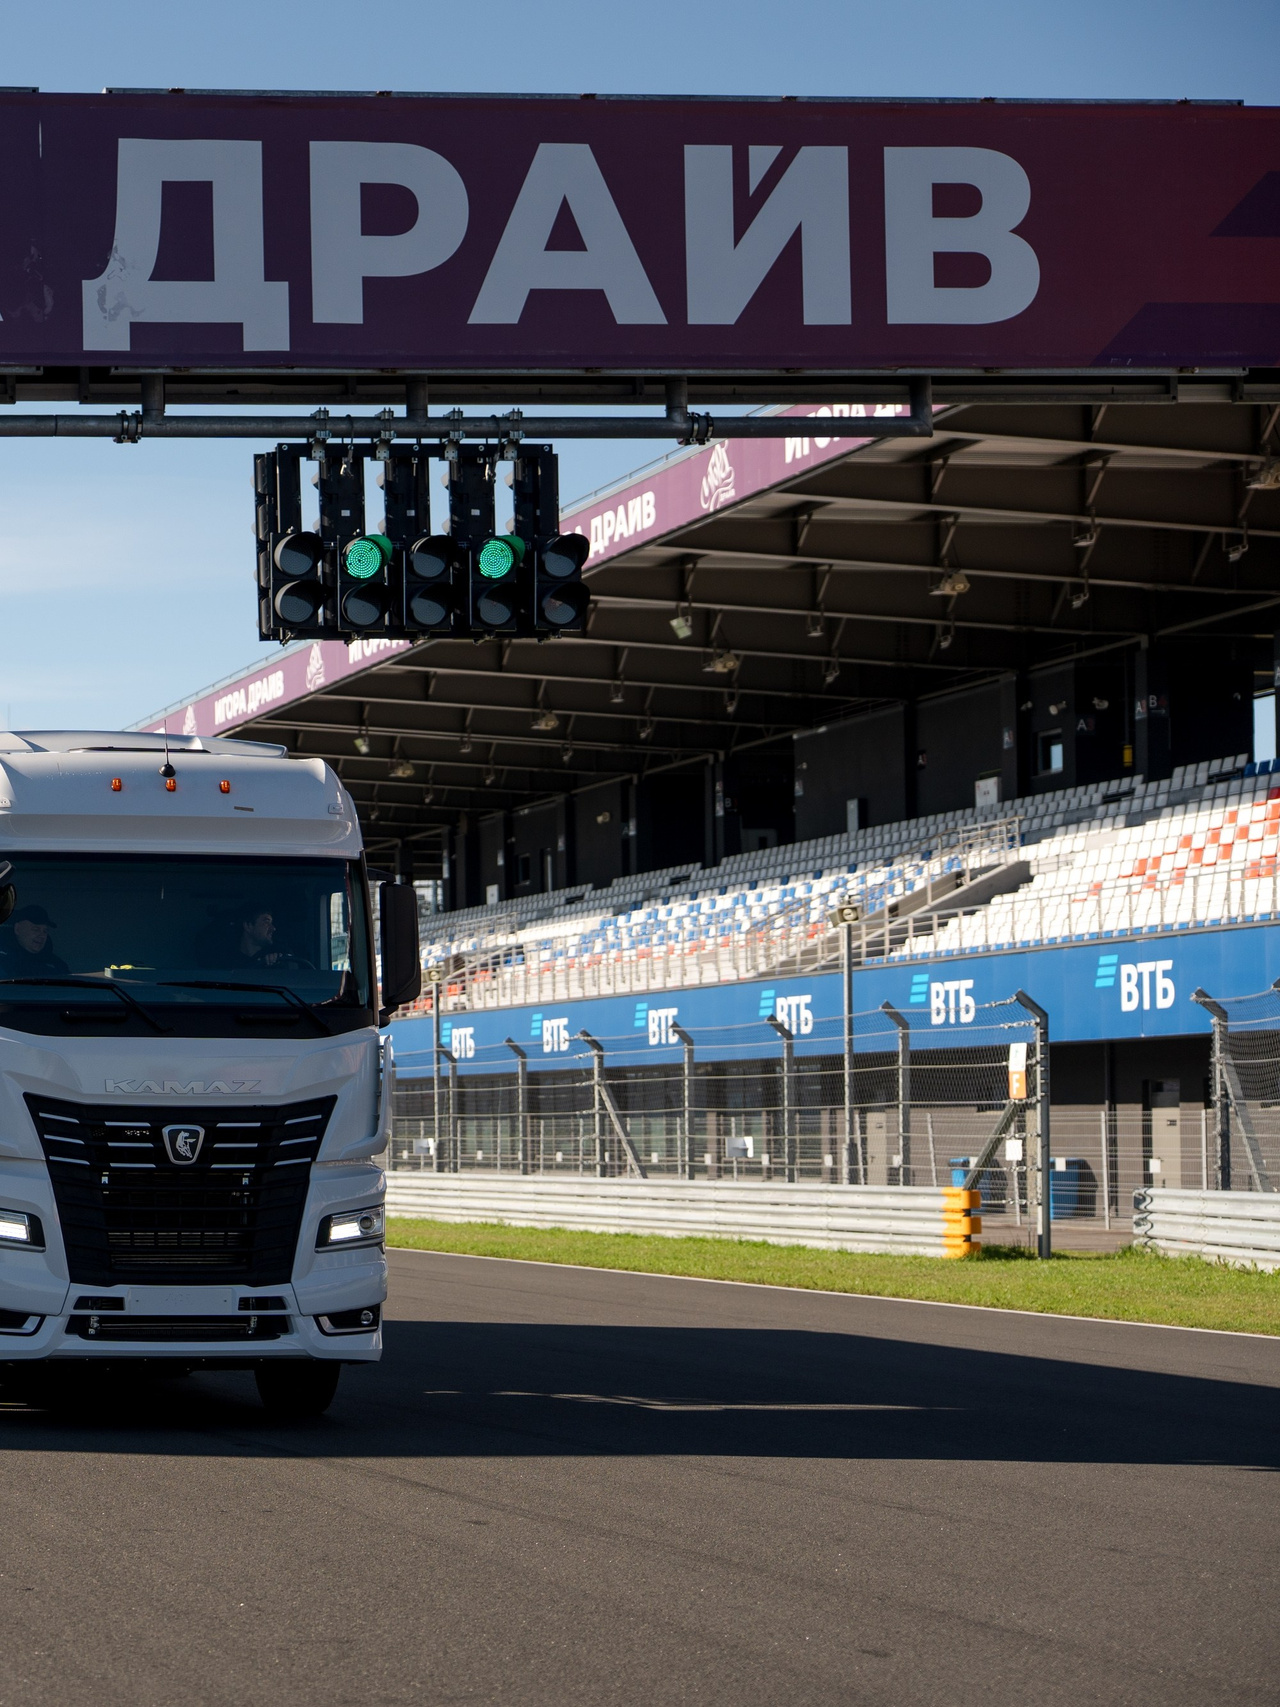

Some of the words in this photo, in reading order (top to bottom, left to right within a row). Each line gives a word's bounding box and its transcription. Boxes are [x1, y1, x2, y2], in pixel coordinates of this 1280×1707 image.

[81, 137, 1041, 352] ДРАЙВ
[589, 491, 656, 559] ДРАЙВ
[214, 688, 247, 726] ИГОРА
[247, 670, 284, 715] ДРАЙВ
[930, 979, 975, 1025] ВТБ
[1121, 959, 1175, 1012] ВТБ
[542, 1017, 569, 1053] ВТБ
[776, 994, 813, 1036] ВТБ
[451, 1026, 475, 1059] ВТБ
[105, 1079, 262, 1095] KAMAZ
[1012, 1073, 1020, 1095] F
